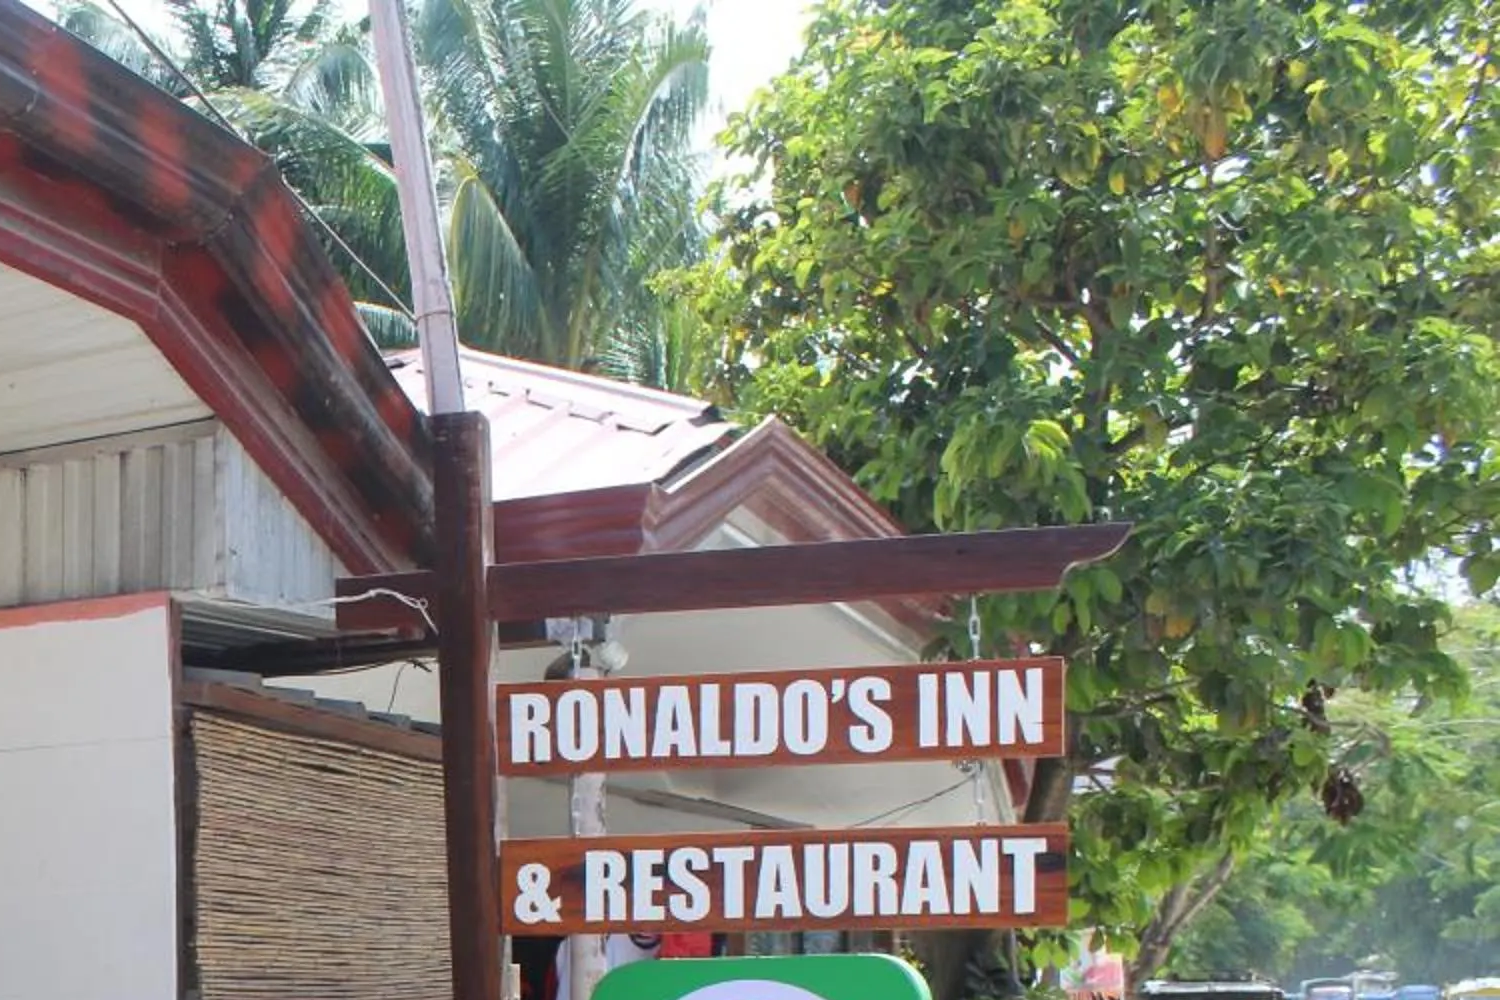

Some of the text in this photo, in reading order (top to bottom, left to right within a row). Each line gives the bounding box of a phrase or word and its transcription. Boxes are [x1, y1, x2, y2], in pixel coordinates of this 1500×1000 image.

[509, 668, 1044, 764] RONALDO'S INN
[514, 837, 1047, 924] & RESTAURANT
